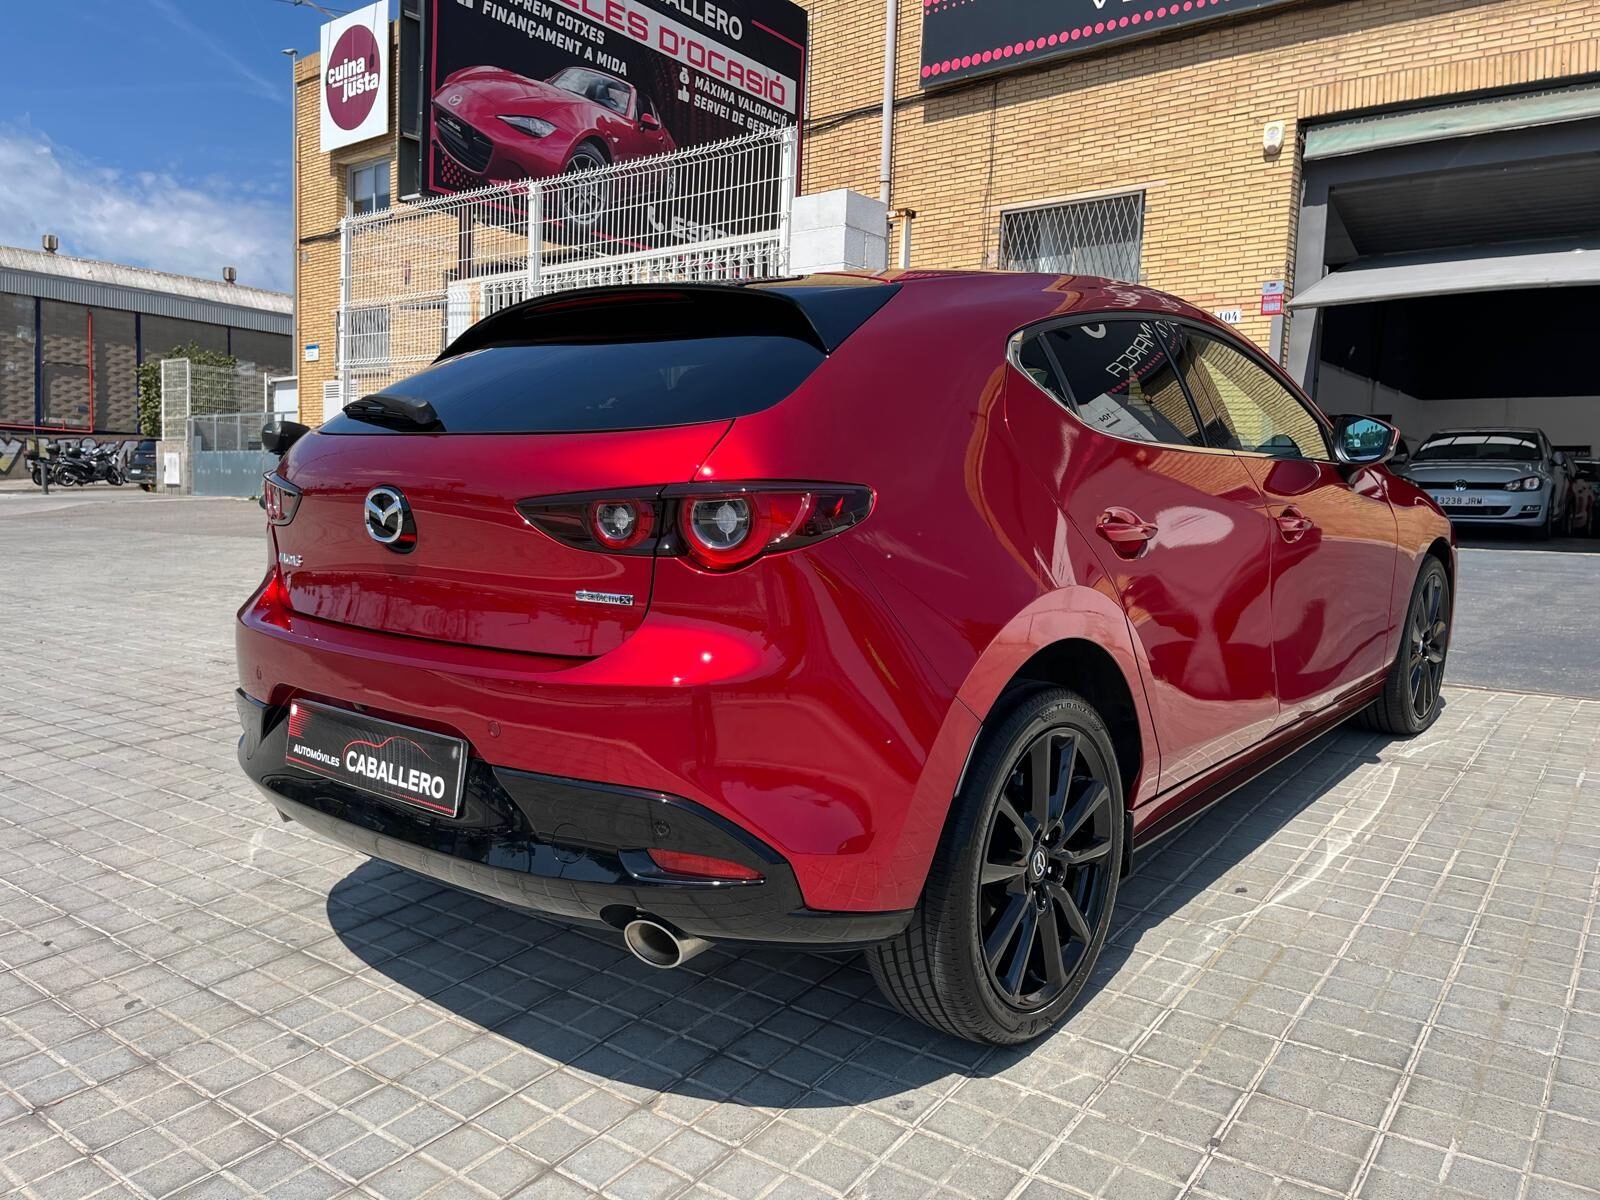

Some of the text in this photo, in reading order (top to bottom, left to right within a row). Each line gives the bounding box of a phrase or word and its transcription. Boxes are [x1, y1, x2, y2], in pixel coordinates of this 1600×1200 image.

[482, 1, 628, 76] FINANÇAMENT A MIDA
[556, 11, 605, 45] COTXES
[328, 57, 366, 84] cuina
[659, 25, 786, 106] D'OCASIÓ
[342, 71, 379, 103] justa
[694, 75, 788, 128] MÀXIMA VALORACIÓ
[693, 94, 730, 120] SERVEI
[732, 110, 746, 126] DE
[1219, 311, 1238, 322] 104
[293, 743, 446, 799] AUTOMÓVILES CABALLERO
